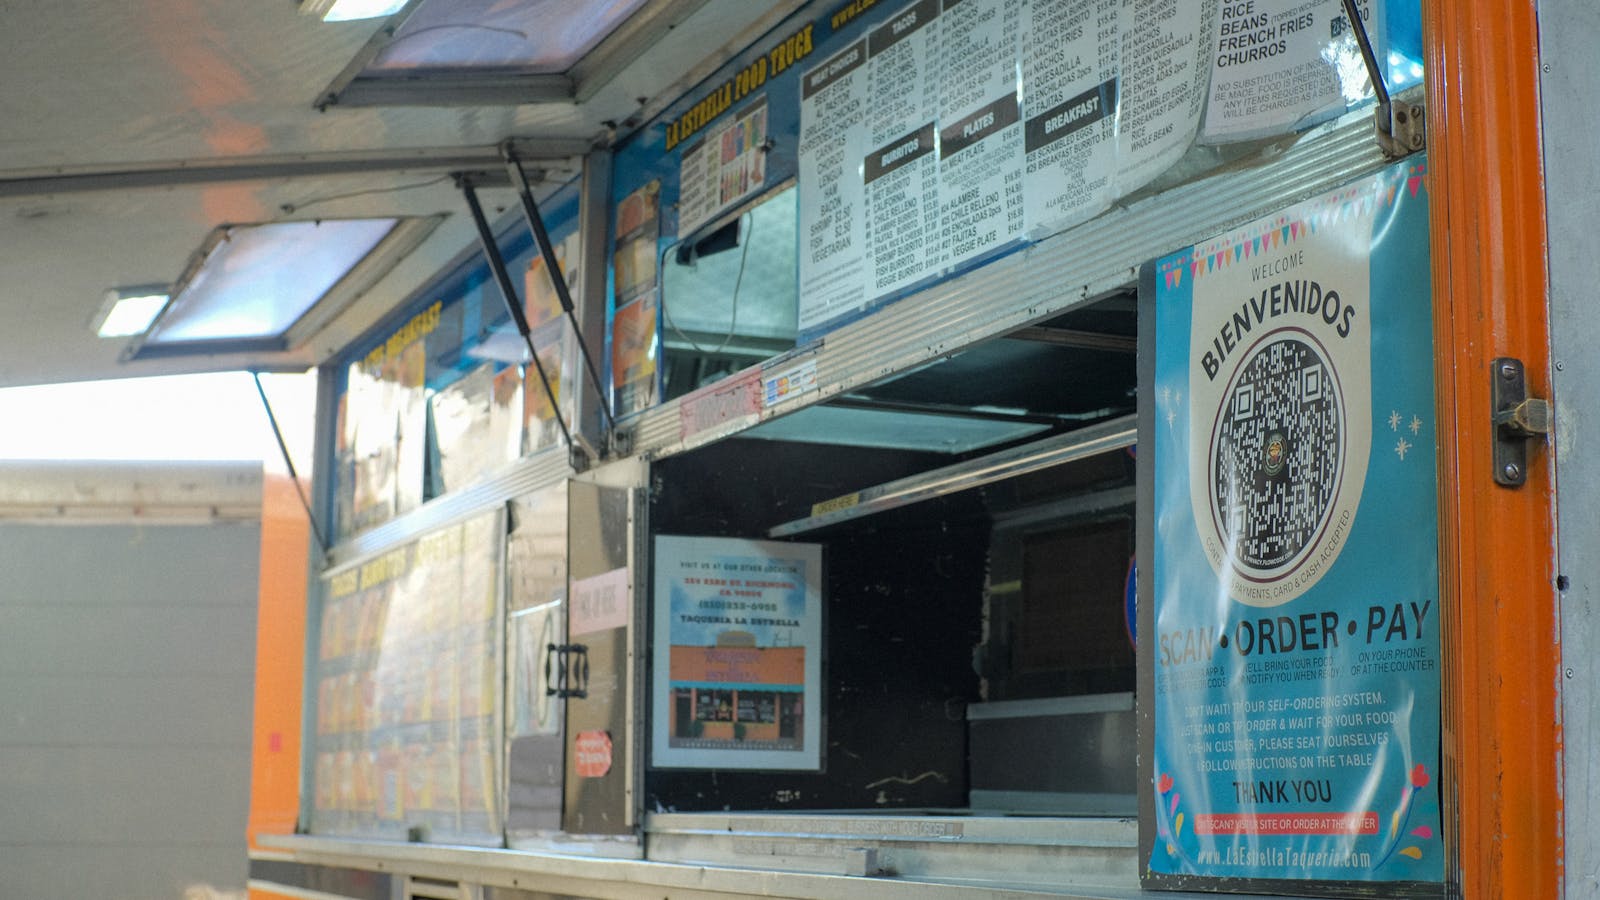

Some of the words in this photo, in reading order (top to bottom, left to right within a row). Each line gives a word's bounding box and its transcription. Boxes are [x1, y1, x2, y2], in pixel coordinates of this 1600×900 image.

[1059, 9, 1090, 33] BURRITO
[1222, 3, 1254, 21] RICE
[1218, 28, 1276, 53] FRENCH
[1279, 12, 1315, 38] FRIES
[1220, 12, 1269, 37] BEANS
[1034, 37, 1060, 60] NACHO
[1060, 25, 1083, 47] FRIES
[1216, 39, 1287, 68] CHURROS
[1034, 49, 1065, 73] NACHOS
[1034, 55, 1081, 88] QUESADILLA
[665, 118, 680, 153] LA
[680, 80, 732, 141] ESTRELLA
[734, 55, 768, 102] FOOD
[769, 23, 814, 80] TRUCK
[1214, 91, 1227, 102] BE
[1258, 81, 1281, 94] FOOD
[1283, 78, 1290, 89] IS
[1217, 82, 1231, 92] NO
[1232, 68, 1292, 90] SUBSTITUTION
[1035, 90, 1063, 113] FAJITAS
[1223, 99, 1243, 111] ANY
[1244, 93, 1269, 107] ITEMS
[1271, 80, 1318, 103] REQUESTED
[1044, 95, 1100, 135] BREAKFAST
[1223, 106, 1245, 120] WILL
[1245, 102, 1257, 116] BE
[1259, 97, 1301, 115] CHARGED
[962, 111, 995, 139] PLATES
[1131, 125, 1147, 141] RICE
[1152, 122, 1174, 142] BEANS
[1038, 134, 1075, 157] SCRAMBLED
[1075, 125, 1094, 142] EGGS
[1038, 147, 1073, 171] BREAKFAST
[1073, 133, 1100, 154] BURRITO
[951, 204, 969, 222] CHILE
[969, 191, 1000, 214] RELLENO
[951, 209, 988, 234] ENCHILADAS
[951, 225, 977, 247] FAJITAS
[951, 237, 976, 257] VEGGIE
[976, 229, 997, 248] PLATE
[1251, 250, 1304, 282] WELCOME
[1201, 279, 1356, 382] BIENVENIDOS
[1235, 583, 1273, 600] PAYMENTS,
[1273, 581, 1294, 596] CARD
[1294, 577, 1301, 589] &
[1300, 560, 1321, 583] CASH
[1320, 509, 1350, 563] ACCEPTED
[680, 615, 732, 625] TAQUERIA
[735, 616, 748, 626] LA
[750, 617, 801, 628] ESTRELLA
[1160, 625, 1214, 668] SCAN
[1235, 611, 1339, 657] ORDER
[1366, 600, 1431, 645] PAY
[1264, 660, 1290, 672] BRING
[1290, 657, 1312, 670] YOUR
[1313, 656, 1334, 668] FOOD
[1358, 652, 1370, 663] ON
[1371, 649, 1393, 662] YOUR
[1394, 647, 1427, 660] PHONE
[1248, 673, 1275, 685] NOTIFY
[1275, 672, 1292, 683] YOU
[1293, 670, 1317, 682] WHEN
[1351, 665, 1361, 677] OR
[1362, 664, 1371, 675] AT
[1371, 662, 1389, 674] THE
[1390, 659, 1434, 673] COUNTER
[1207, 678, 1227, 689] CODE
[1205, 703, 1231, 716] WAIT!
[1244, 701, 1265, 713] OUR
[1267, 695, 1341, 712] SELF-ORDERING
[1342, 691, 1387, 706] SYSTEM.
[1217, 722, 1231, 734] OR
[1246, 718, 1277, 732] ORDER
[1279, 718, 1286, 730] &
[1289, 717, 1314, 730] WAIT
[1316, 715, 1334, 729] FOR
[1335, 713, 1363, 727] YOUR
[1259, 737, 1294, 750] PLEASE
[1296, 735, 1321, 749] SEAT
[1322, 731, 1389, 748] YOURSELVES
[1300, 756, 1314, 769] ON
[1316, 755, 1336, 768] THE
[1337, 753, 1373, 767] TABLE
[1233, 780, 1290, 804] THANK
[1290, 779, 1332, 804] YOU
[1210, 820, 1235, 831] SCAN?
[1259, 819, 1278, 830] SITE
[1279, 818, 1292, 829] OR
[1293, 818, 1320, 830] ORDER
[1320, 818, 1332, 829] AT
[1332, 818, 1345, 829] THE
